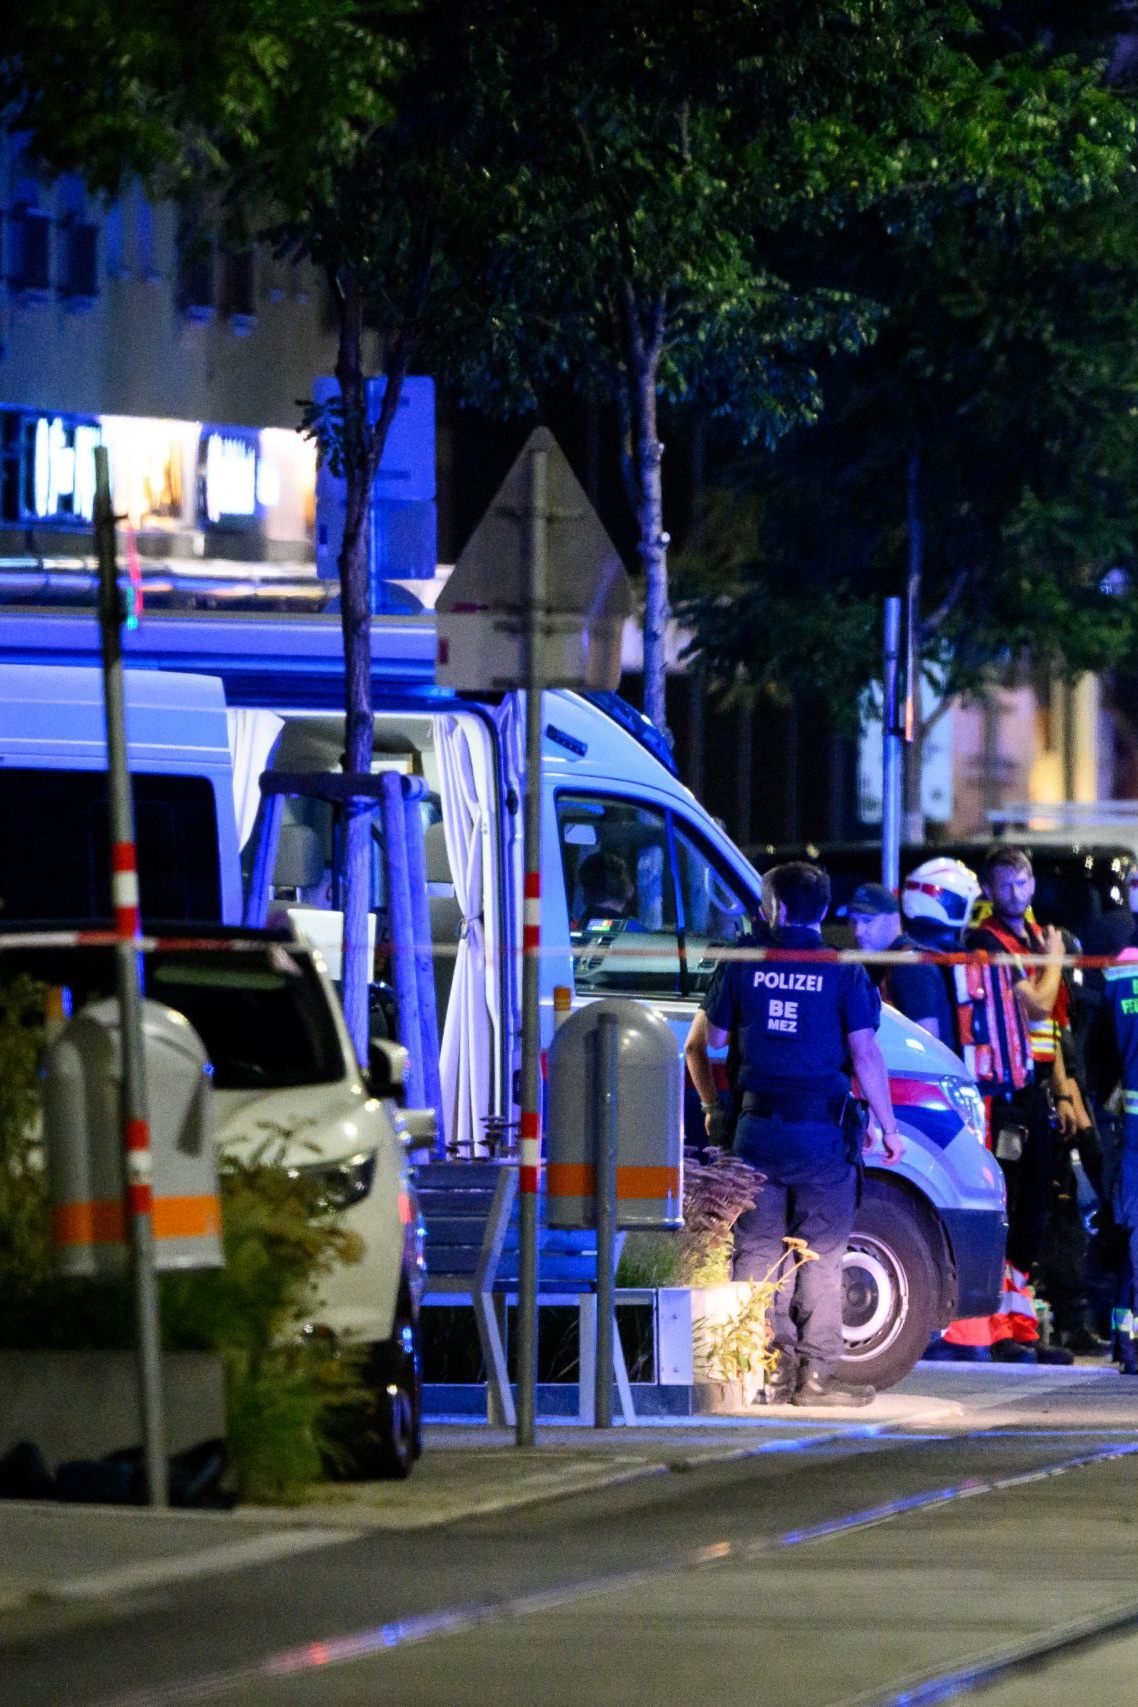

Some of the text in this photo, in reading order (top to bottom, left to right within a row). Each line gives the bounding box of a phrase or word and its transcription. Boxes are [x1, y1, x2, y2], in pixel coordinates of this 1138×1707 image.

[753, 971, 823, 992] POLIZEI
[768, 999, 799, 1020] BE
[767, 1018, 798, 1033] MEZ
